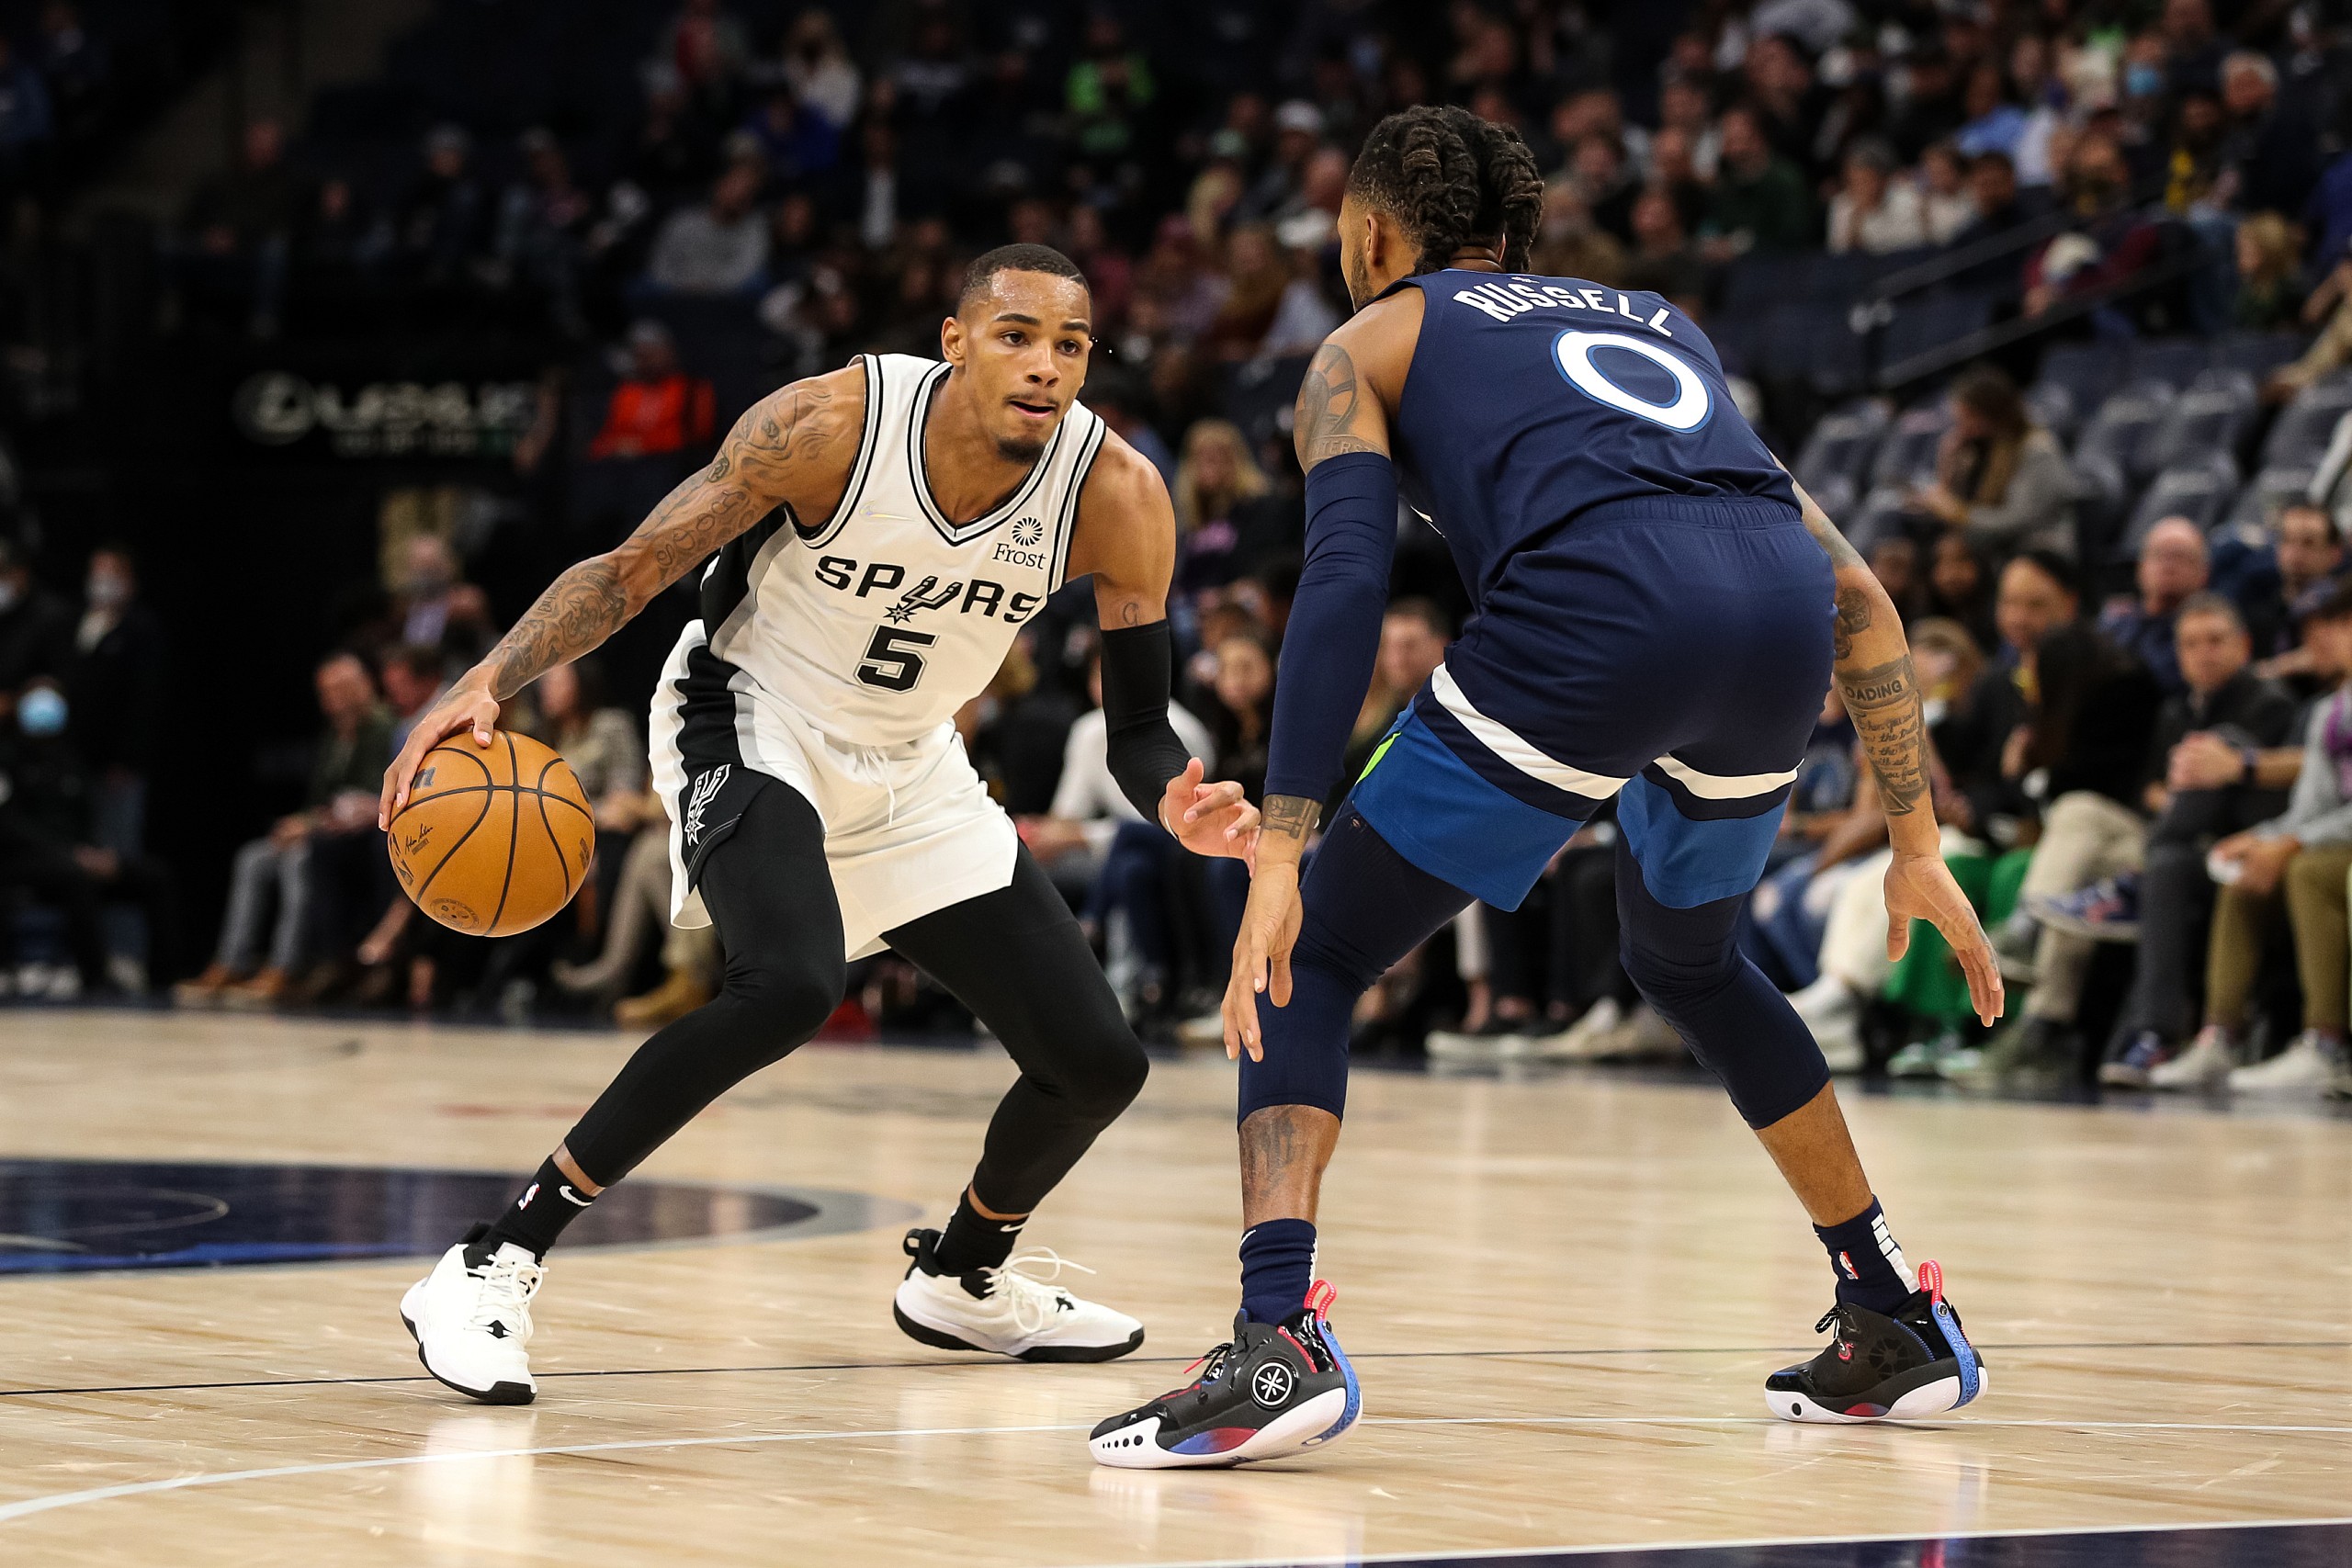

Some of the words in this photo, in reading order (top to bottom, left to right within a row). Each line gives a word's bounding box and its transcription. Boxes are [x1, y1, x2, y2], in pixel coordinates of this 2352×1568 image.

[1453, 282, 1673, 338] RUSSELL
[1550, 328, 1714, 434] 0
[992, 542, 1047, 570] Frost
[815, 555, 1043, 625] SPURS
[853, 624, 941, 694] 5
[1843, 680, 1903, 701] OADING
